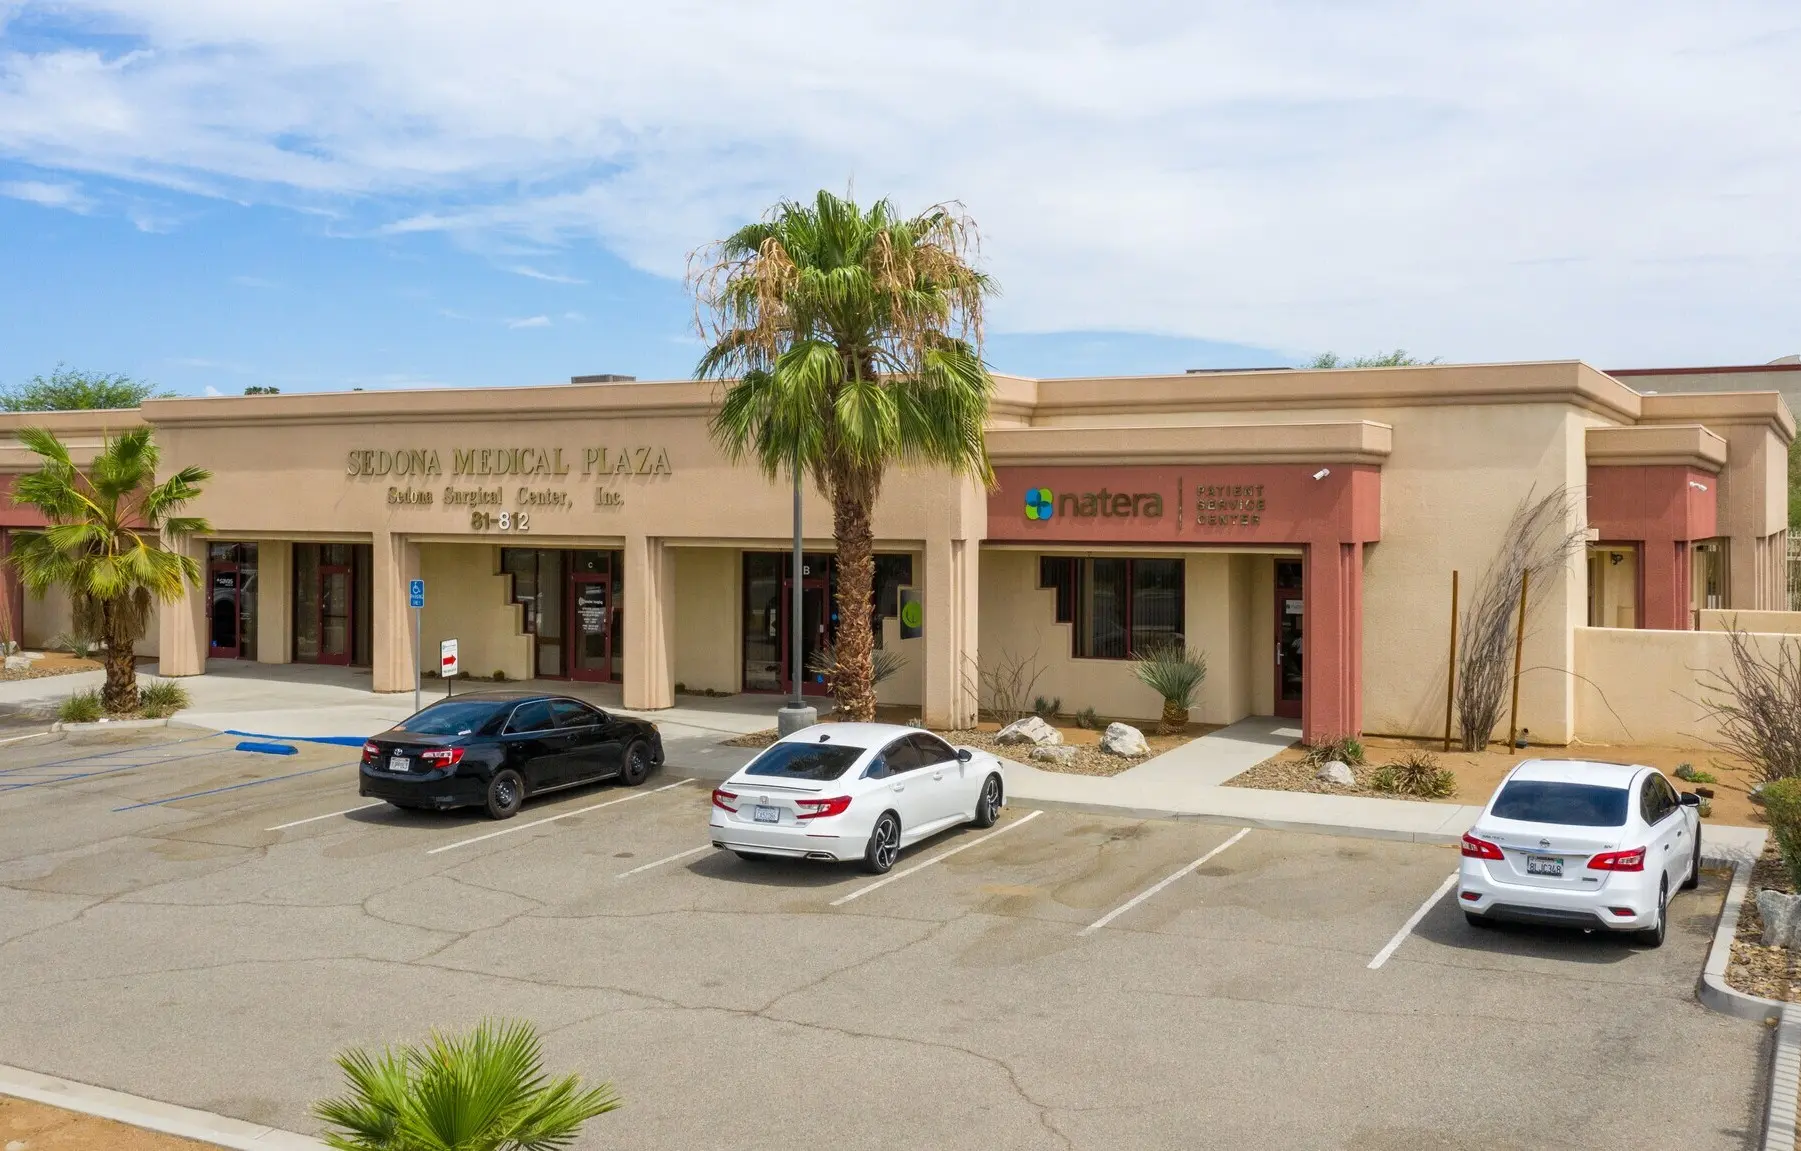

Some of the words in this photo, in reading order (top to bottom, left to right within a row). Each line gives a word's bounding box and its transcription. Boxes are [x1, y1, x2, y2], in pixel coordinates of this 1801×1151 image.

[346, 449, 442, 476] SEDONA
[452, 447, 570, 476] MEDICAL
[581, 447, 672, 475] PLAZA
[1197, 485, 1265, 497] PATIENT
[387, 486, 434, 505] Sedona
[443, 486, 503, 508] Surgical
[516, 486, 573, 509] Center,
[595, 486, 625, 506] Inc.
[1058, 487, 1163, 518] natera
[1197, 499, 1265, 511] SERVICE
[471, 511, 530, 531] 81-812
[1197, 514, 1261, 526] CENTER
[587, 561, 594, 569] C
[803, 565, 810, 576] B
